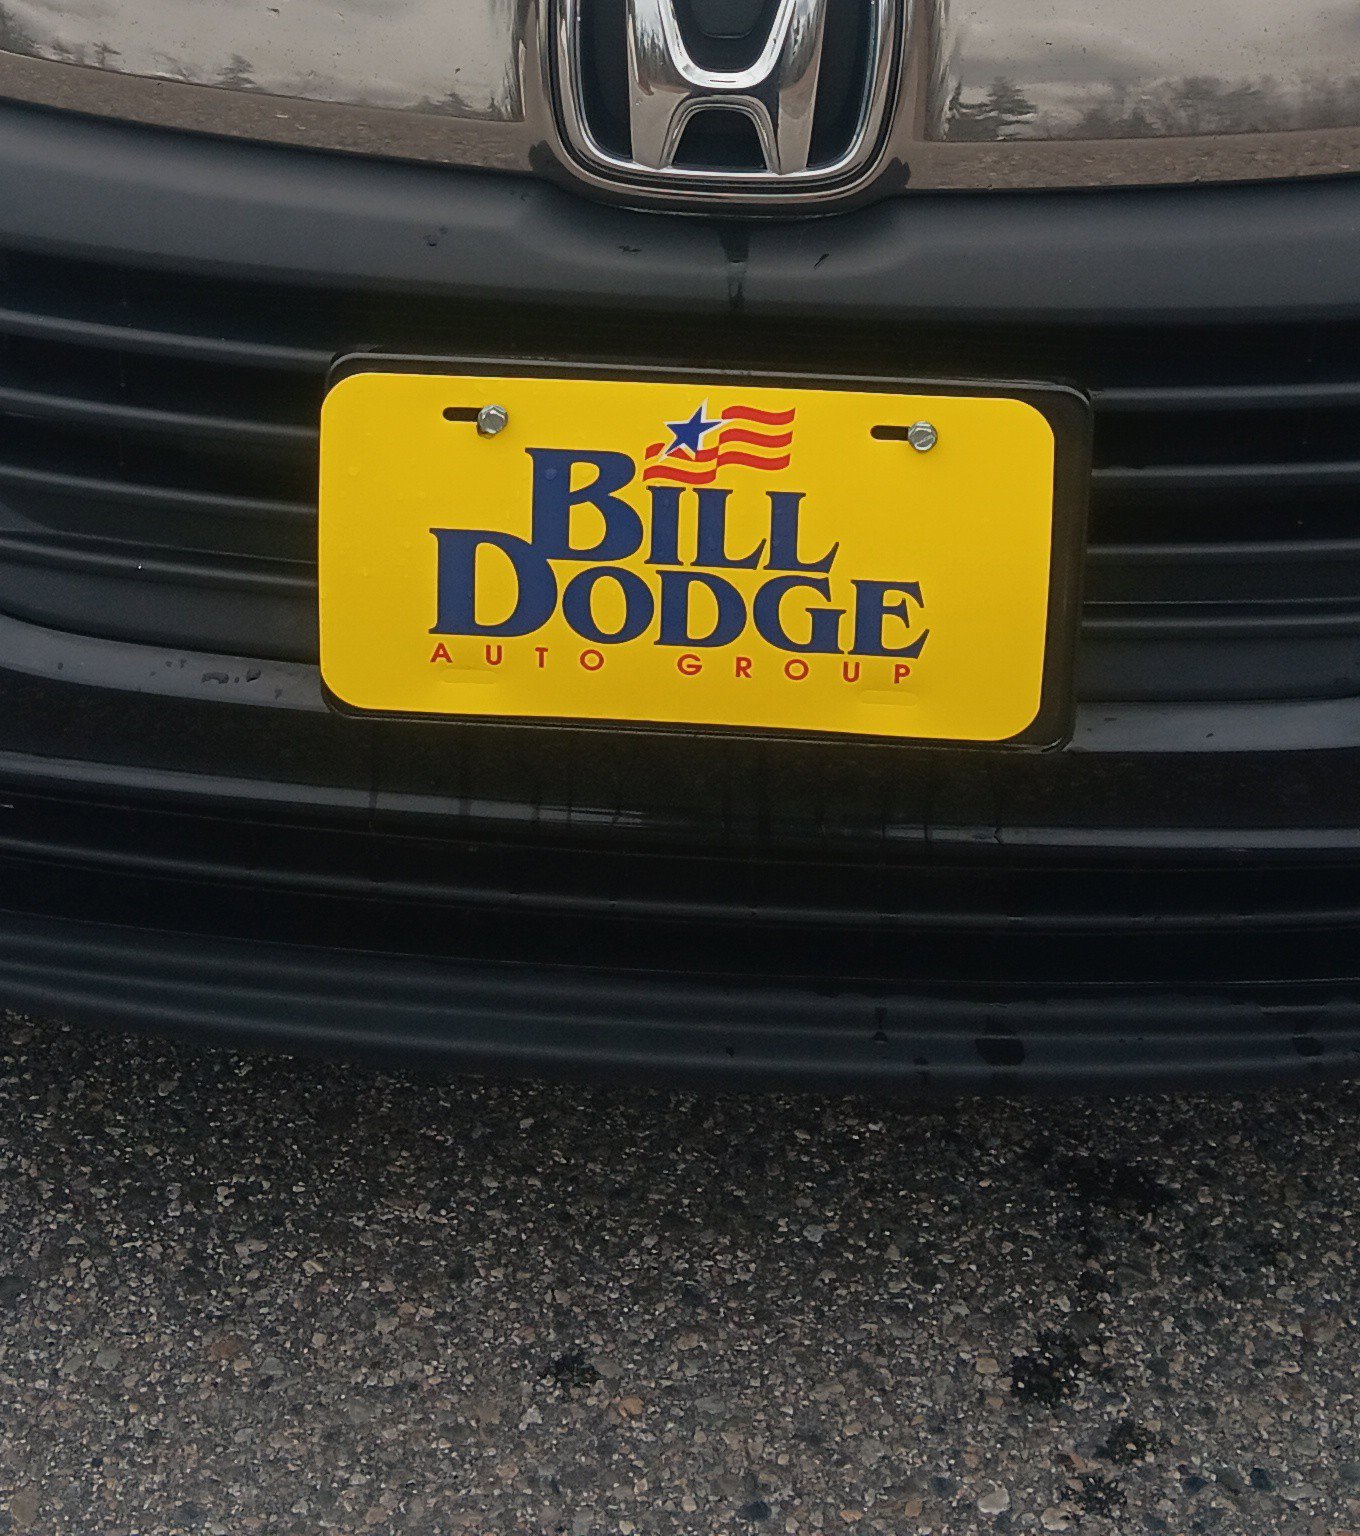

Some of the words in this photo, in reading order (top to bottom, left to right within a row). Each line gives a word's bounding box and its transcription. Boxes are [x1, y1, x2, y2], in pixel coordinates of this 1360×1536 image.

[524, 446, 840, 573] BILL
[428, 527, 931, 661] DODGE
[429, 642, 606, 672] AUTO
[676, 652, 913, 685] GROUP
